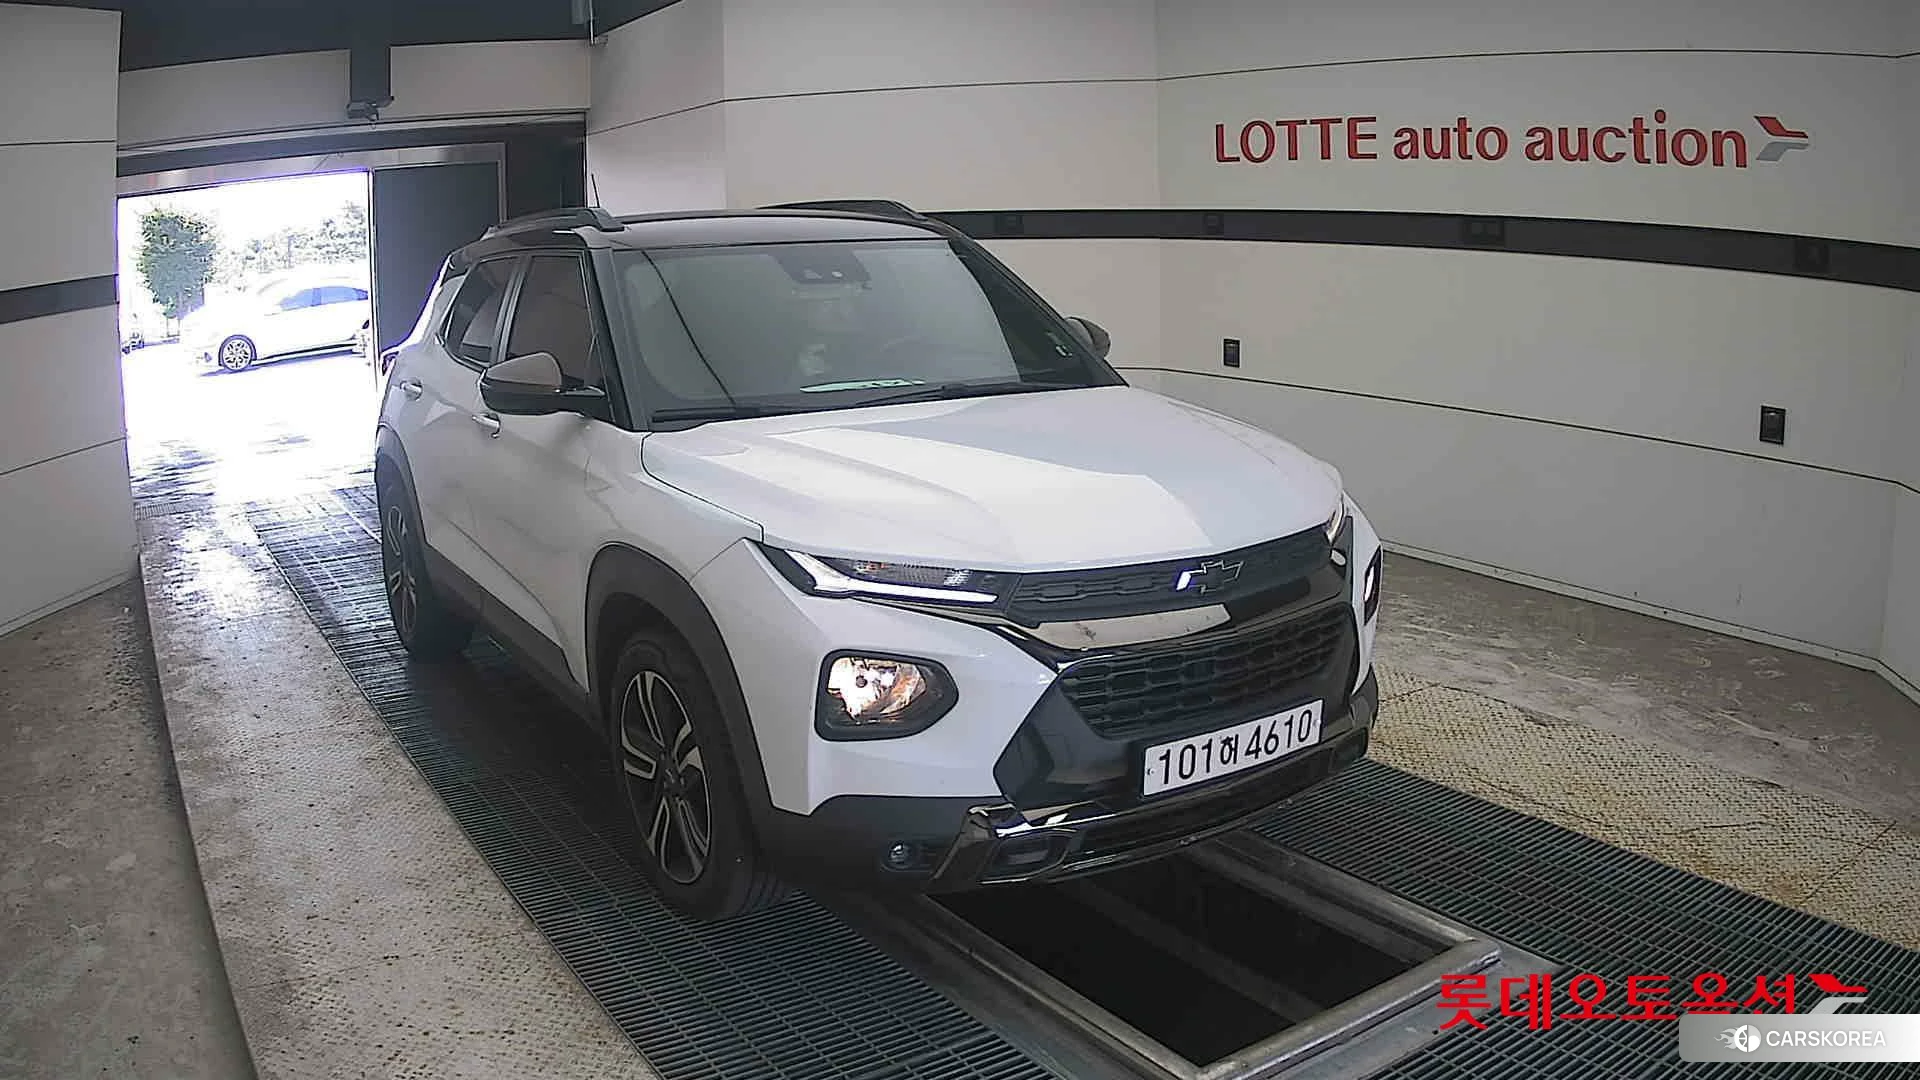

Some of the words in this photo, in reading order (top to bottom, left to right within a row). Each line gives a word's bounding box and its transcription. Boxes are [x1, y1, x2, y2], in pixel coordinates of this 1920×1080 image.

[1214, 116, 1378, 163] LOTTE
[1393, 117, 1508, 161] auto
[1525, 109, 1747, 169] auction
